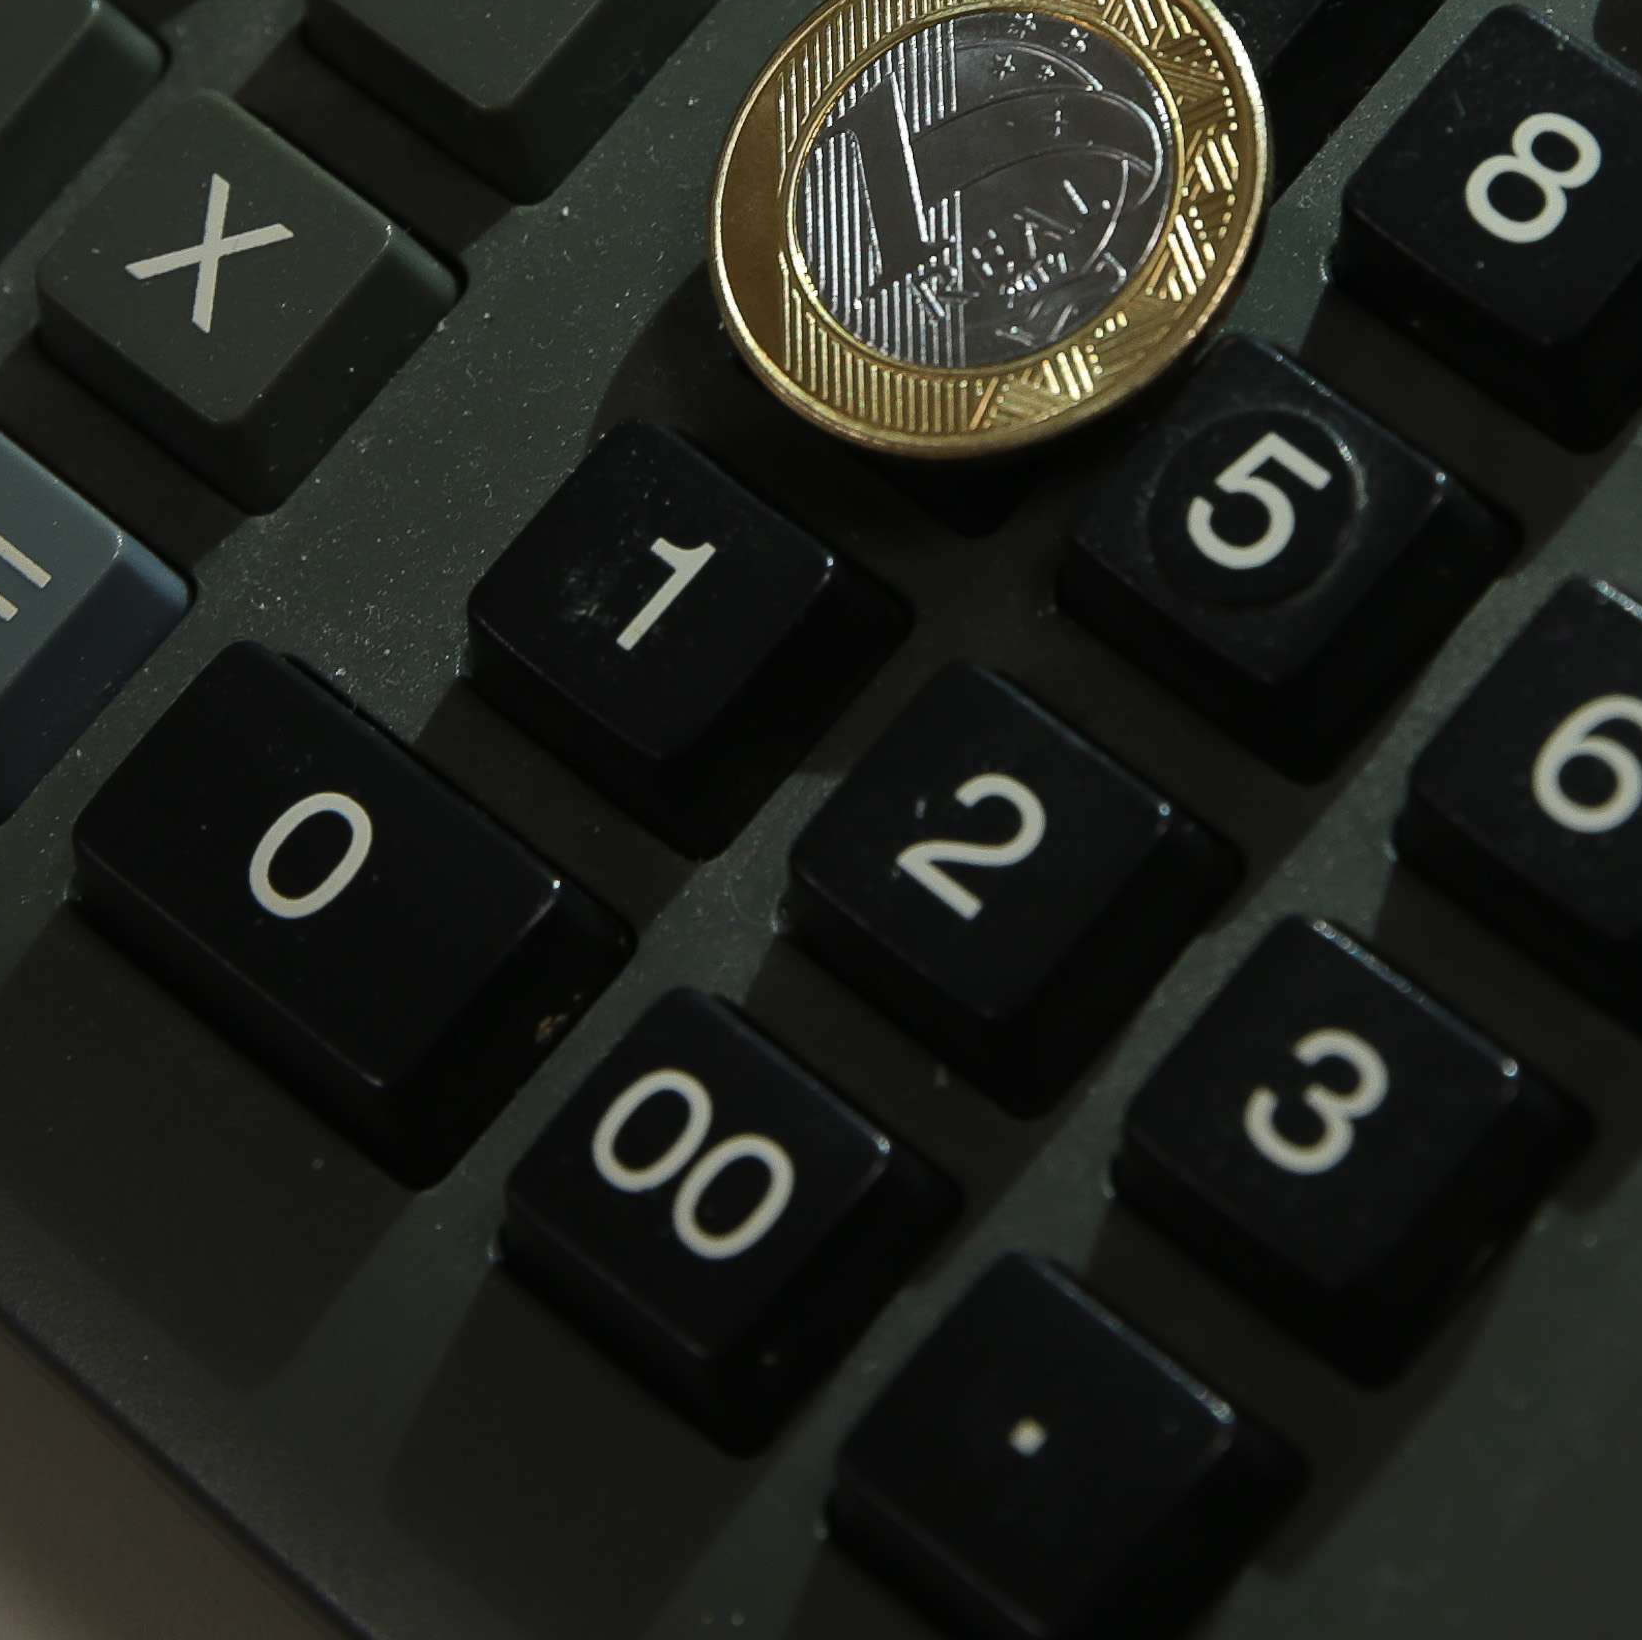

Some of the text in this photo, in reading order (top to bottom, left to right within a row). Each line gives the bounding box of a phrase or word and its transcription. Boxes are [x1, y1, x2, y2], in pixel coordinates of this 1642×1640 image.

[1465, 112, 1602, 243] 8
[1187, 432, 1331, 569] 5
[616, 537, 716, 651] 1
[249, 791, 373, 919] 0
[896, 773, 1046, 919] 2
[592, 1069, 794, 1259] 00
[1245, 1029, 1388, 1174] 3
